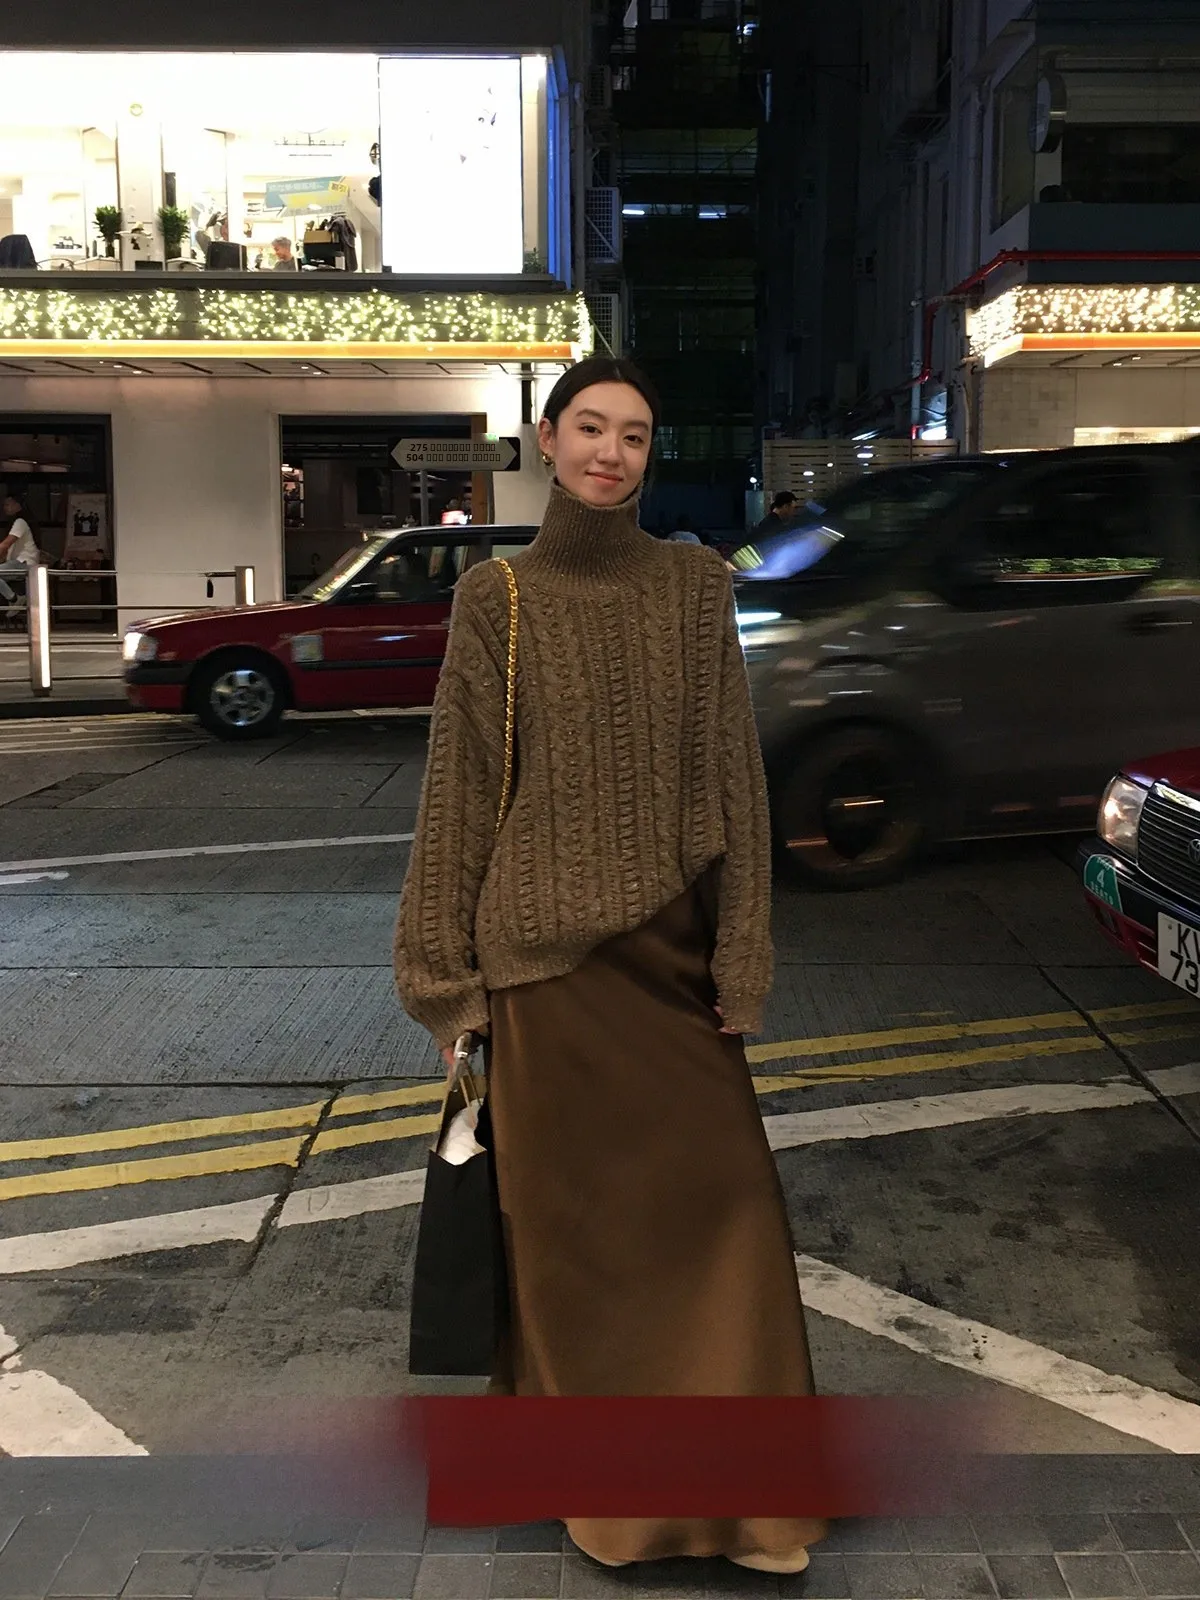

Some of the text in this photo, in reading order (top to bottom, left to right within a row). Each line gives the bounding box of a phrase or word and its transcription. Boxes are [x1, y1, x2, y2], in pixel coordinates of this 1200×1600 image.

[410, 443, 428, 452] 275
[406, 453, 424, 462] 504
[1096, 869, 1105, 888] 4
[1170, 949, 1199, 994] 73
